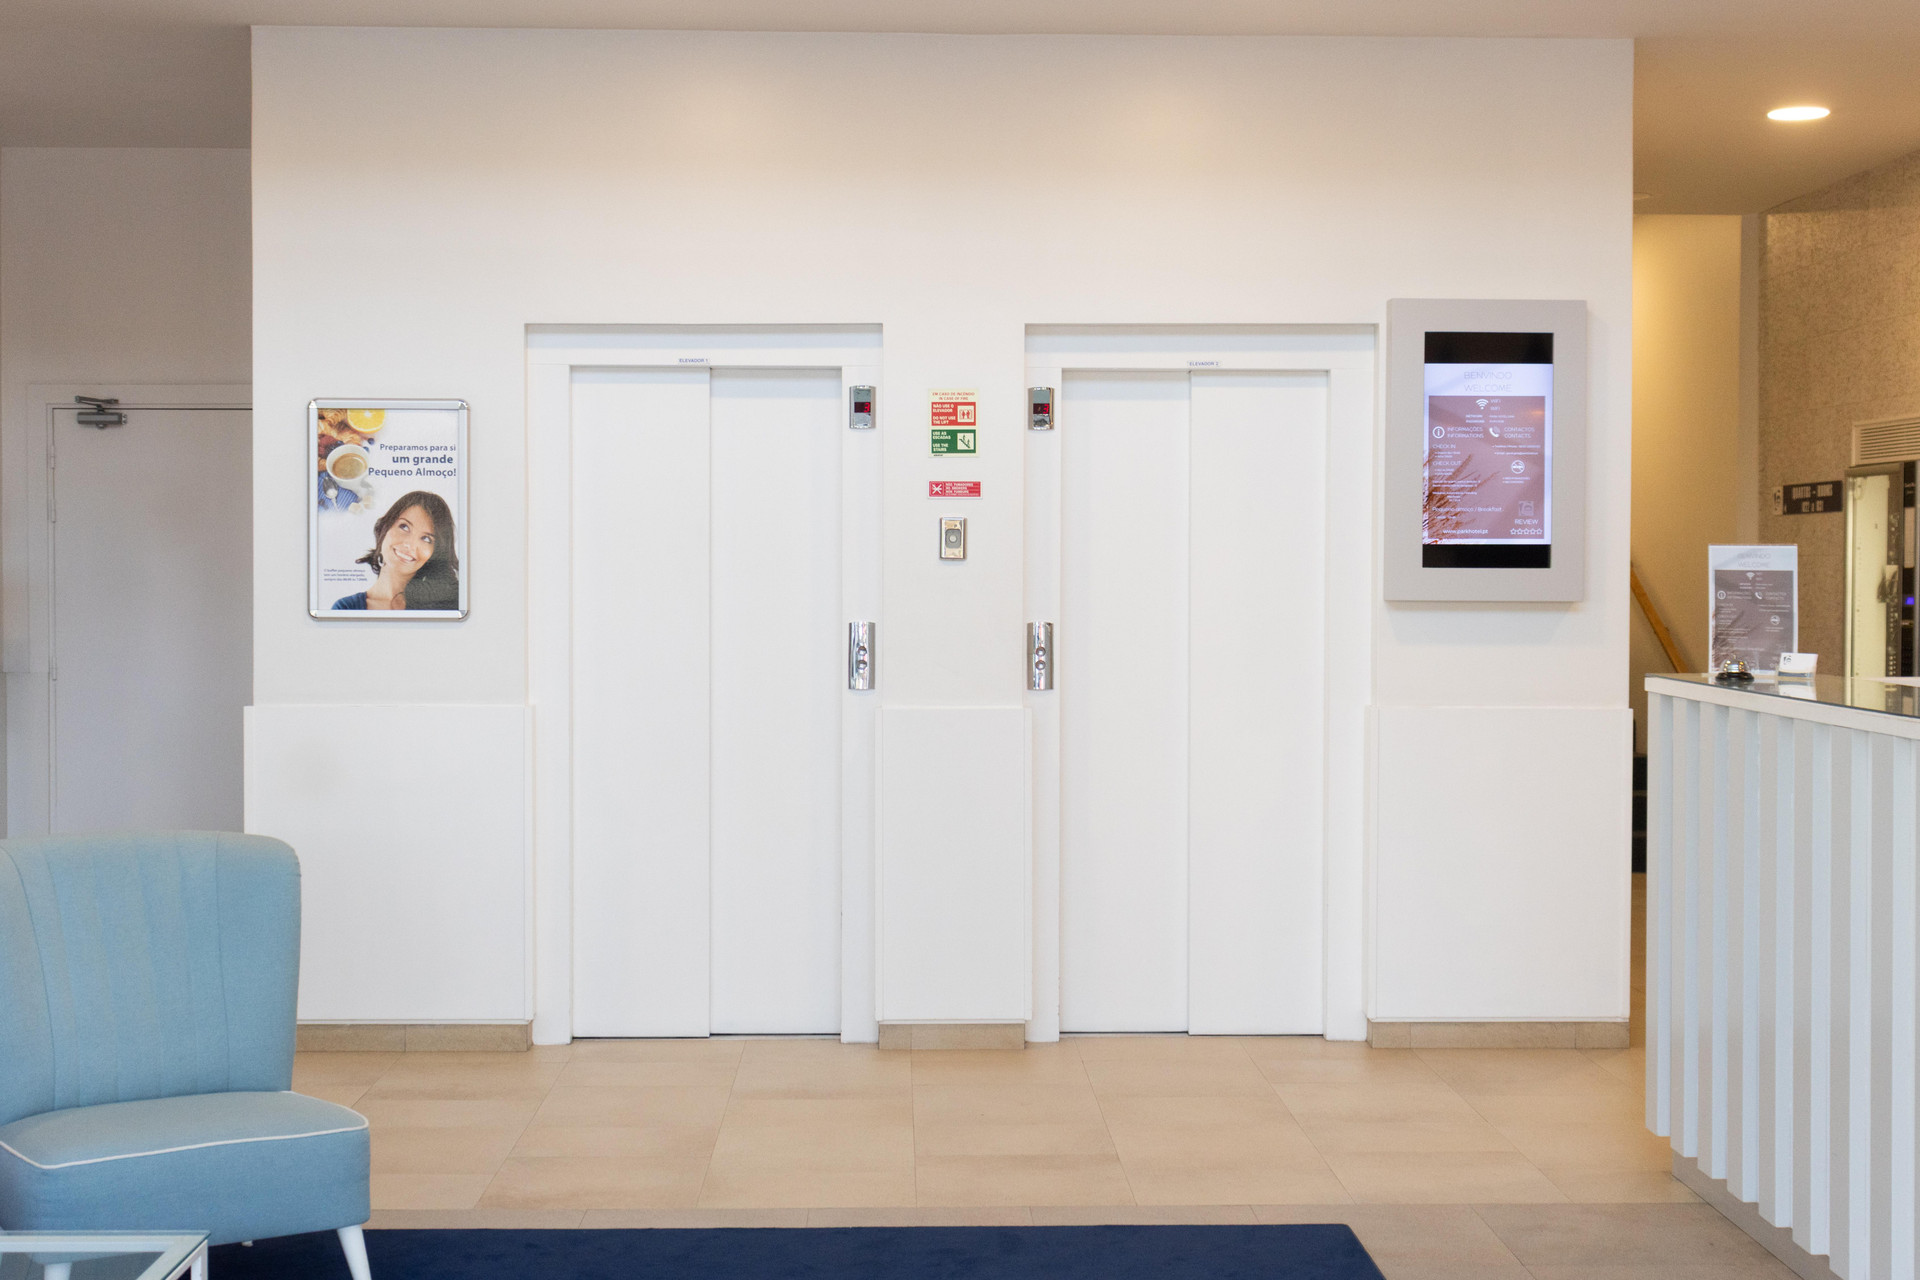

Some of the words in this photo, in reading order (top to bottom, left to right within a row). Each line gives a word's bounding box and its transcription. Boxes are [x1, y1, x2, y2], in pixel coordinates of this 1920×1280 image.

[1464, 371, 1512, 379] BENVINDO
[1464, 384, 1512, 392] WELCOME
[864, 402, 870, 413] 3
[1043, 403, 1049, 414] 3
[380, 444, 428, 452] Preparamos
[412, 454, 453, 465] grande
[368, 467, 413, 478] Pequeno
[415, 468, 456, 478] Almoço!
